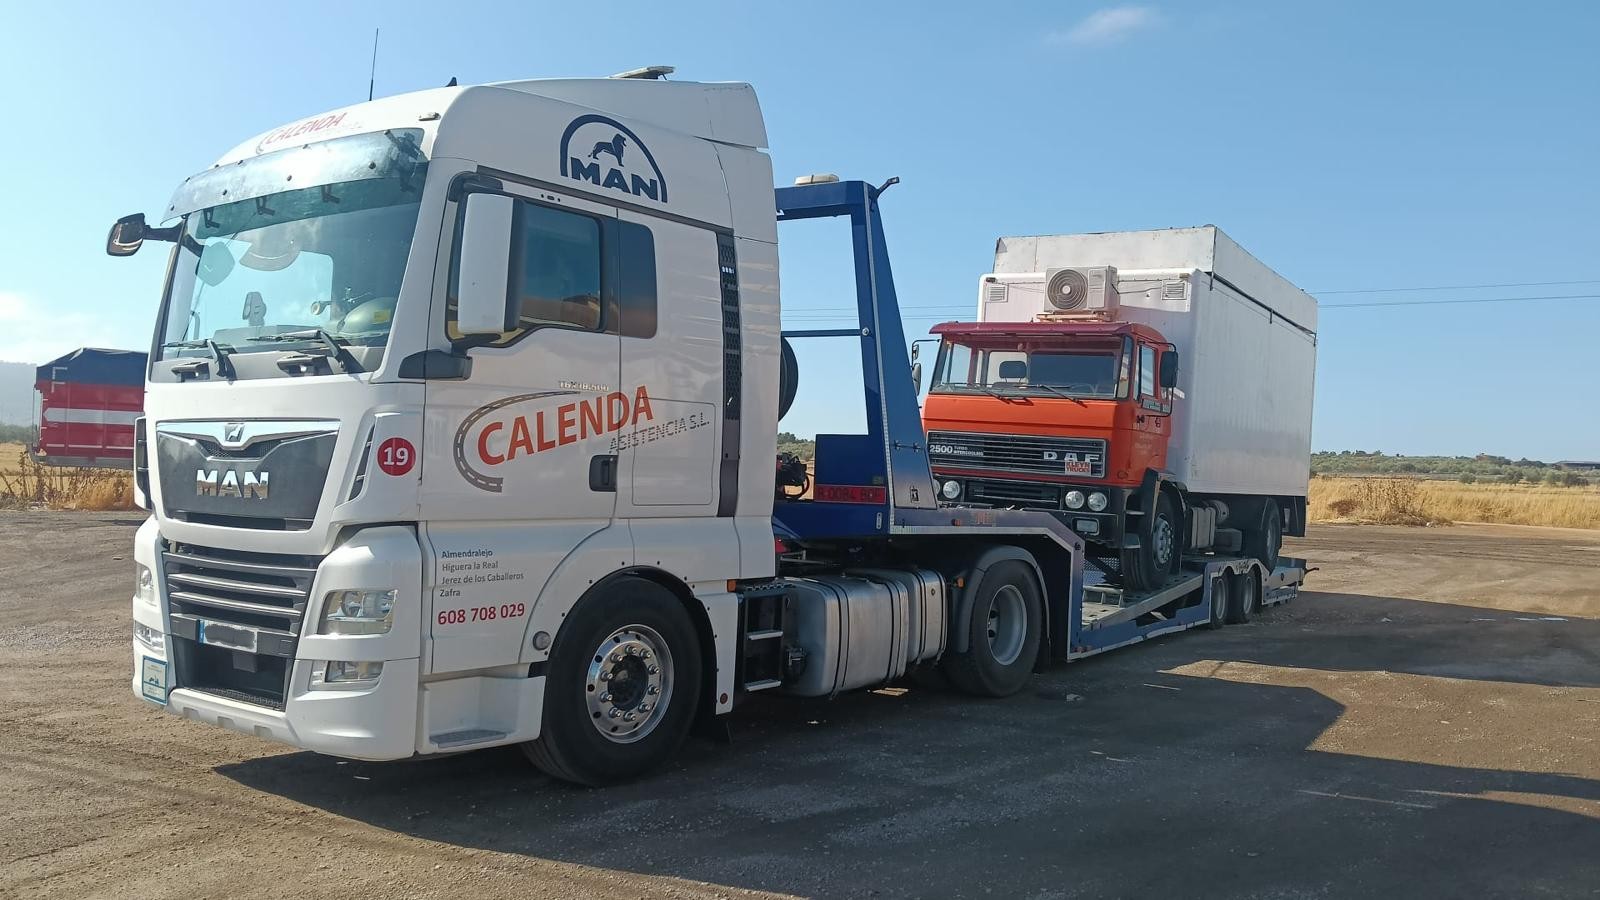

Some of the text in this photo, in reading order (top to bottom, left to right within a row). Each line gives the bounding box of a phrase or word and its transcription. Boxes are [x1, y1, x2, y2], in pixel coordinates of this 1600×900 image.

[264, 111, 347, 145] CALENDA
[570, 156, 659, 201] MAN
[477, 385, 654, 466] CALENDA
[609, 412, 710, 454] ASISTENCIA S.L.
[383, 447, 409, 466] 19
[929, 444, 953, 454] 2500
[1043, 451, 1100, 463] DAF
[196, 469, 269, 499] MAN
[441, 549, 493, 559] Almendralejo
[442, 561, 499, 573] Higuera la Real
[441, 572, 524, 585] Jerez de los Caballeros
[440, 588, 461, 597] Zafra
[437, 603, 525, 625] 608 708 029
